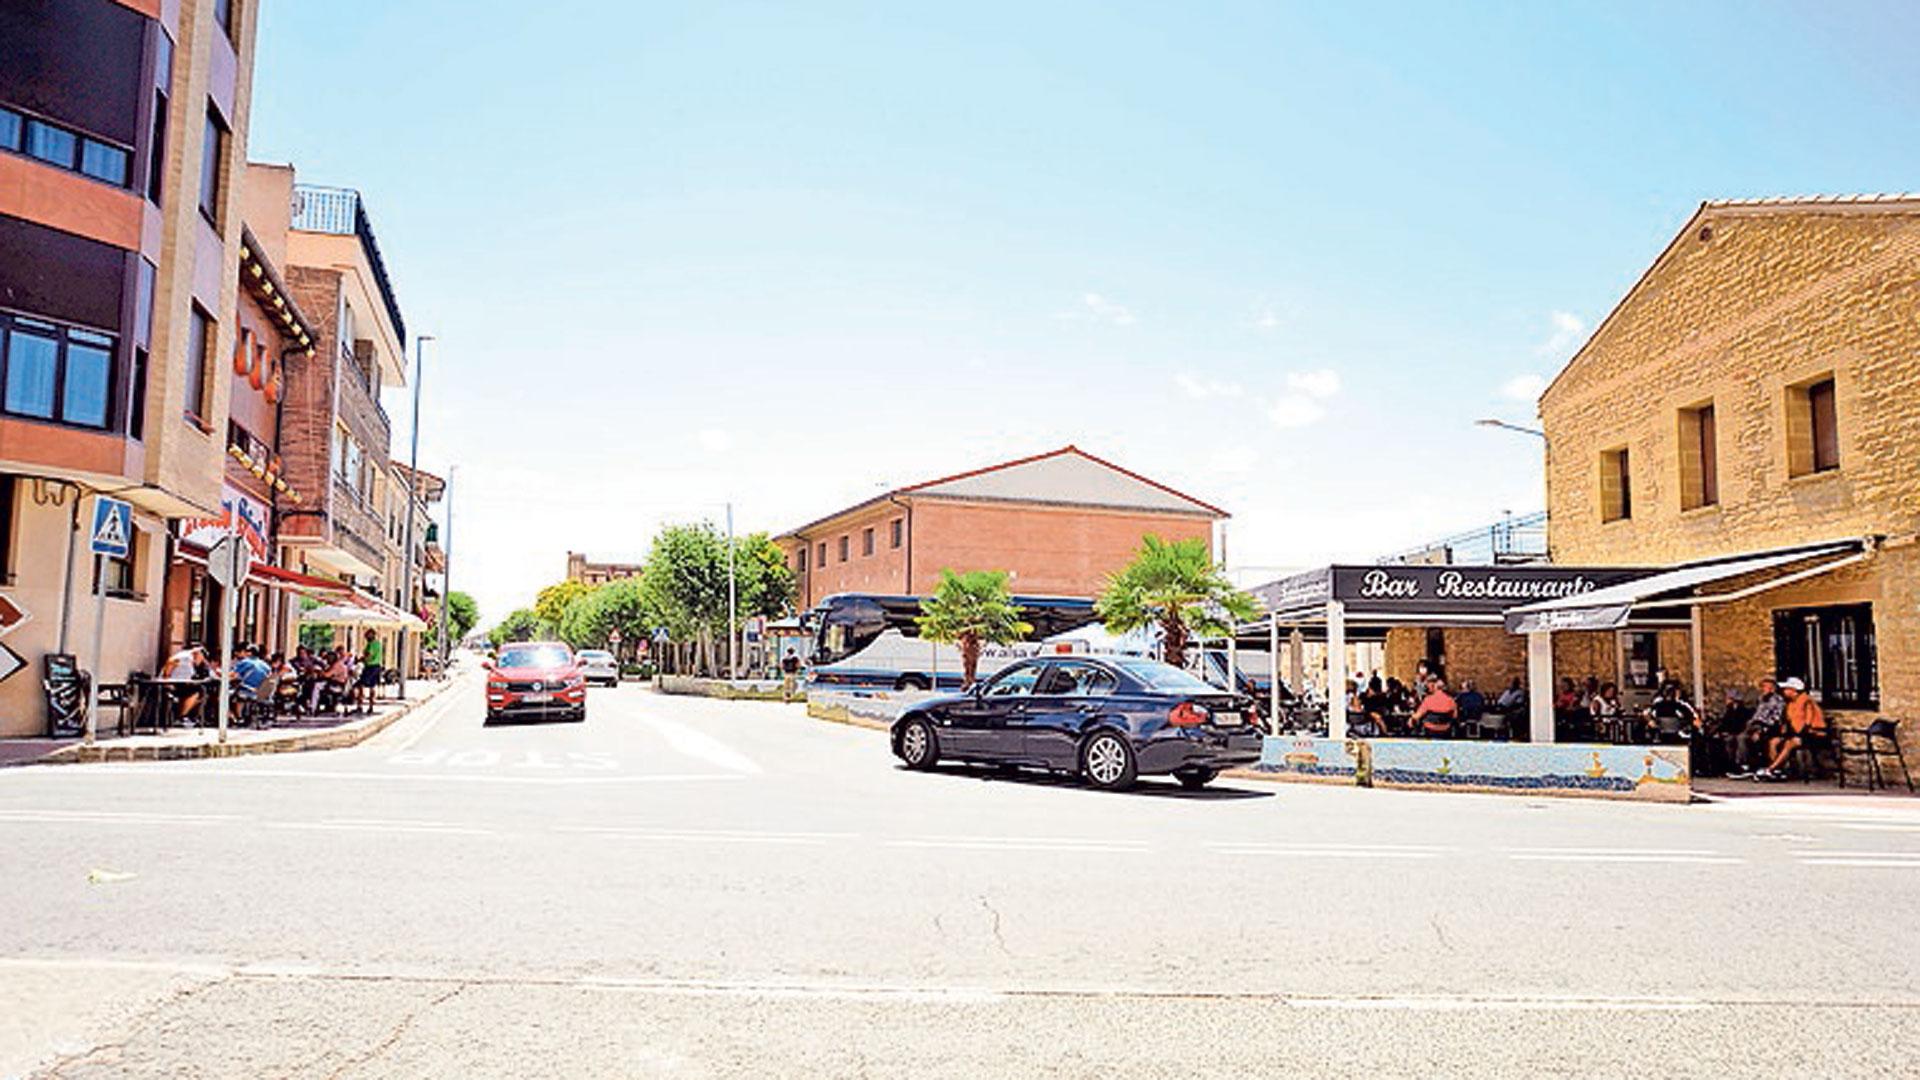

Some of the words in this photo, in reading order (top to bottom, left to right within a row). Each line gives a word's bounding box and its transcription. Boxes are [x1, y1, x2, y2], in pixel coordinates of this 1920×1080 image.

[1361, 569, 1420, 598] Bar
[1436, 570, 1597, 598] Restaurante
[386, 750, 621, 770] STOP
